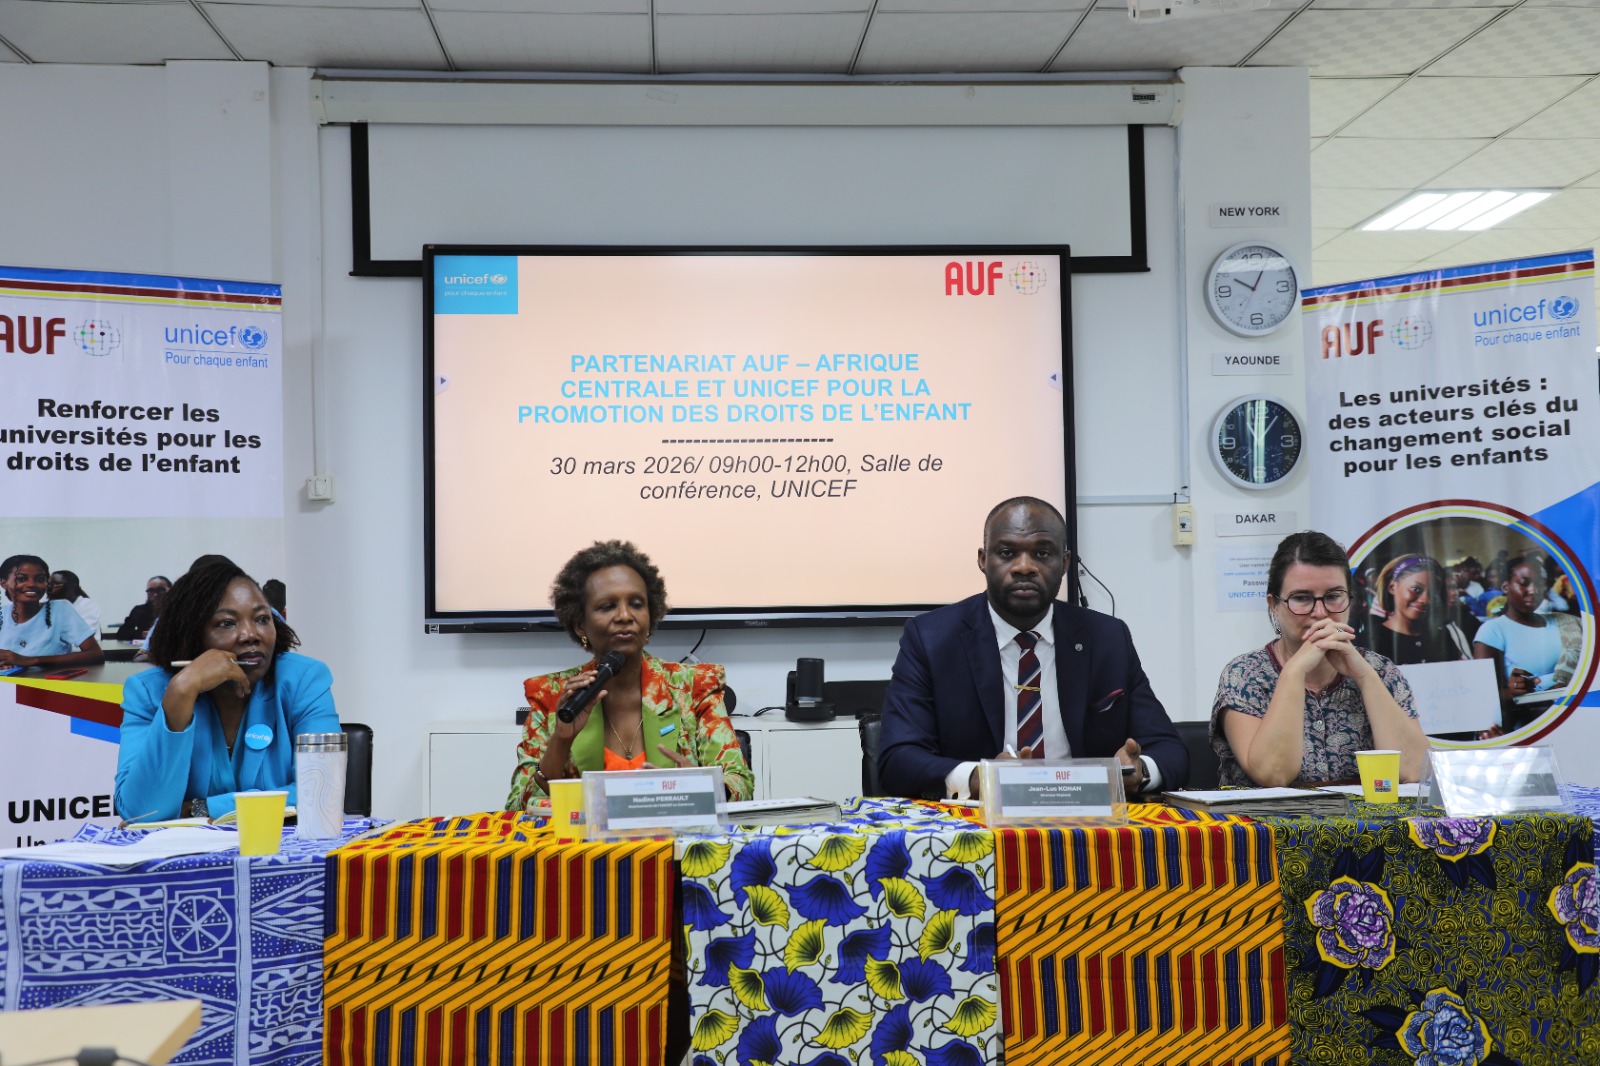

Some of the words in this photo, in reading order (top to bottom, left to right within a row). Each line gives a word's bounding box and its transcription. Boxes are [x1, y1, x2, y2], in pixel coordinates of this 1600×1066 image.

[1219, 207, 1246, 217] NEW
[1247, 206, 1280, 216] YORK
[444, 273, 489, 285] unicef
[945, 261, 1003, 296] AUF
[1276, 280, 1290, 293] 3
[1218, 285, 1232, 298] 9
[1250, 312, 1264, 326] 6
[1473, 299, 1546, 327] unicef
[164, 323, 237, 346] unicef
[1321, 319, 1384, 359] AUF
[1474, 334, 1500, 347] Pour
[1502, 330, 1542, 346] chaque
[1545, 325, 1581, 339] enfant
[165, 351, 191, 365] Pour
[193, 353, 233, 368] chaque
[235, 355, 268, 368] enfant
[570, 354, 736, 373] PARTENARIAT
[742, 354, 790, 373] AUF
[815, 353, 919, 373] AFRIQUE
[1224, 356, 1280, 365] YAOUNDE
[560, 379, 690, 399] CENTRALE
[696, 379, 726, 398] ET
[733, 379, 820, 398] UNICEF
[827, 378, 894, 397] POUR
[901, 378, 931, 397] LA
[1339, 391, 1382, 408] Les
[1390, 376, 1531, 404] universités
[37, 398, 174, 422] Renforcer
[182, 403, 220, 423] les
[518, 404, 664, 424] PROMOTION
[671, 404, 719, 423] DES
[726, 403, 815, 423] DROITS
[822, 403, 853, 422] DE
[1328, 413, 1371, 431] des
[1378, 405, 1475, 427] acteurs
[1483, 400, 1537, 419] clés
[1546, 395, 1579, 414] du
[157, 431, 216, 451] pour
[224, 430, 262, 449] les
[1222, 437, 1236, 450] 9
[1280, 435, 1294, 448] 3
[1329, 426, 1483, 452] changement
[1491, 419, 1571, 442] social
[6, 451, 90, 472] droits
[99, 453, 132, 472] de
[549, 456, 577, 476] 30
[583, 460, 636, 475] mars
[643, 455, 705, 475] 2026/
[708, 454, 852, 476] 09h00-12h00,
[860, 453, 911, 473] Salle
[918, 453, 943, 472] de
[1344, 458, 1398, 478] pour
[1406, 452, 1442, 470] les
[1450, 445, 1549, 467] enfants
[639, 480, 762, 502] conférence,
[770, 479, 858, 498] UNICEF
[1235, 513, 1276, 524] DAKAR
[1228, 591, 1267, 599] UNICEF-12
[245, 732, 264, 740] unicef
[662, 780, 677, 790] AUF
[1055, 771, 1071, 781] AUF
